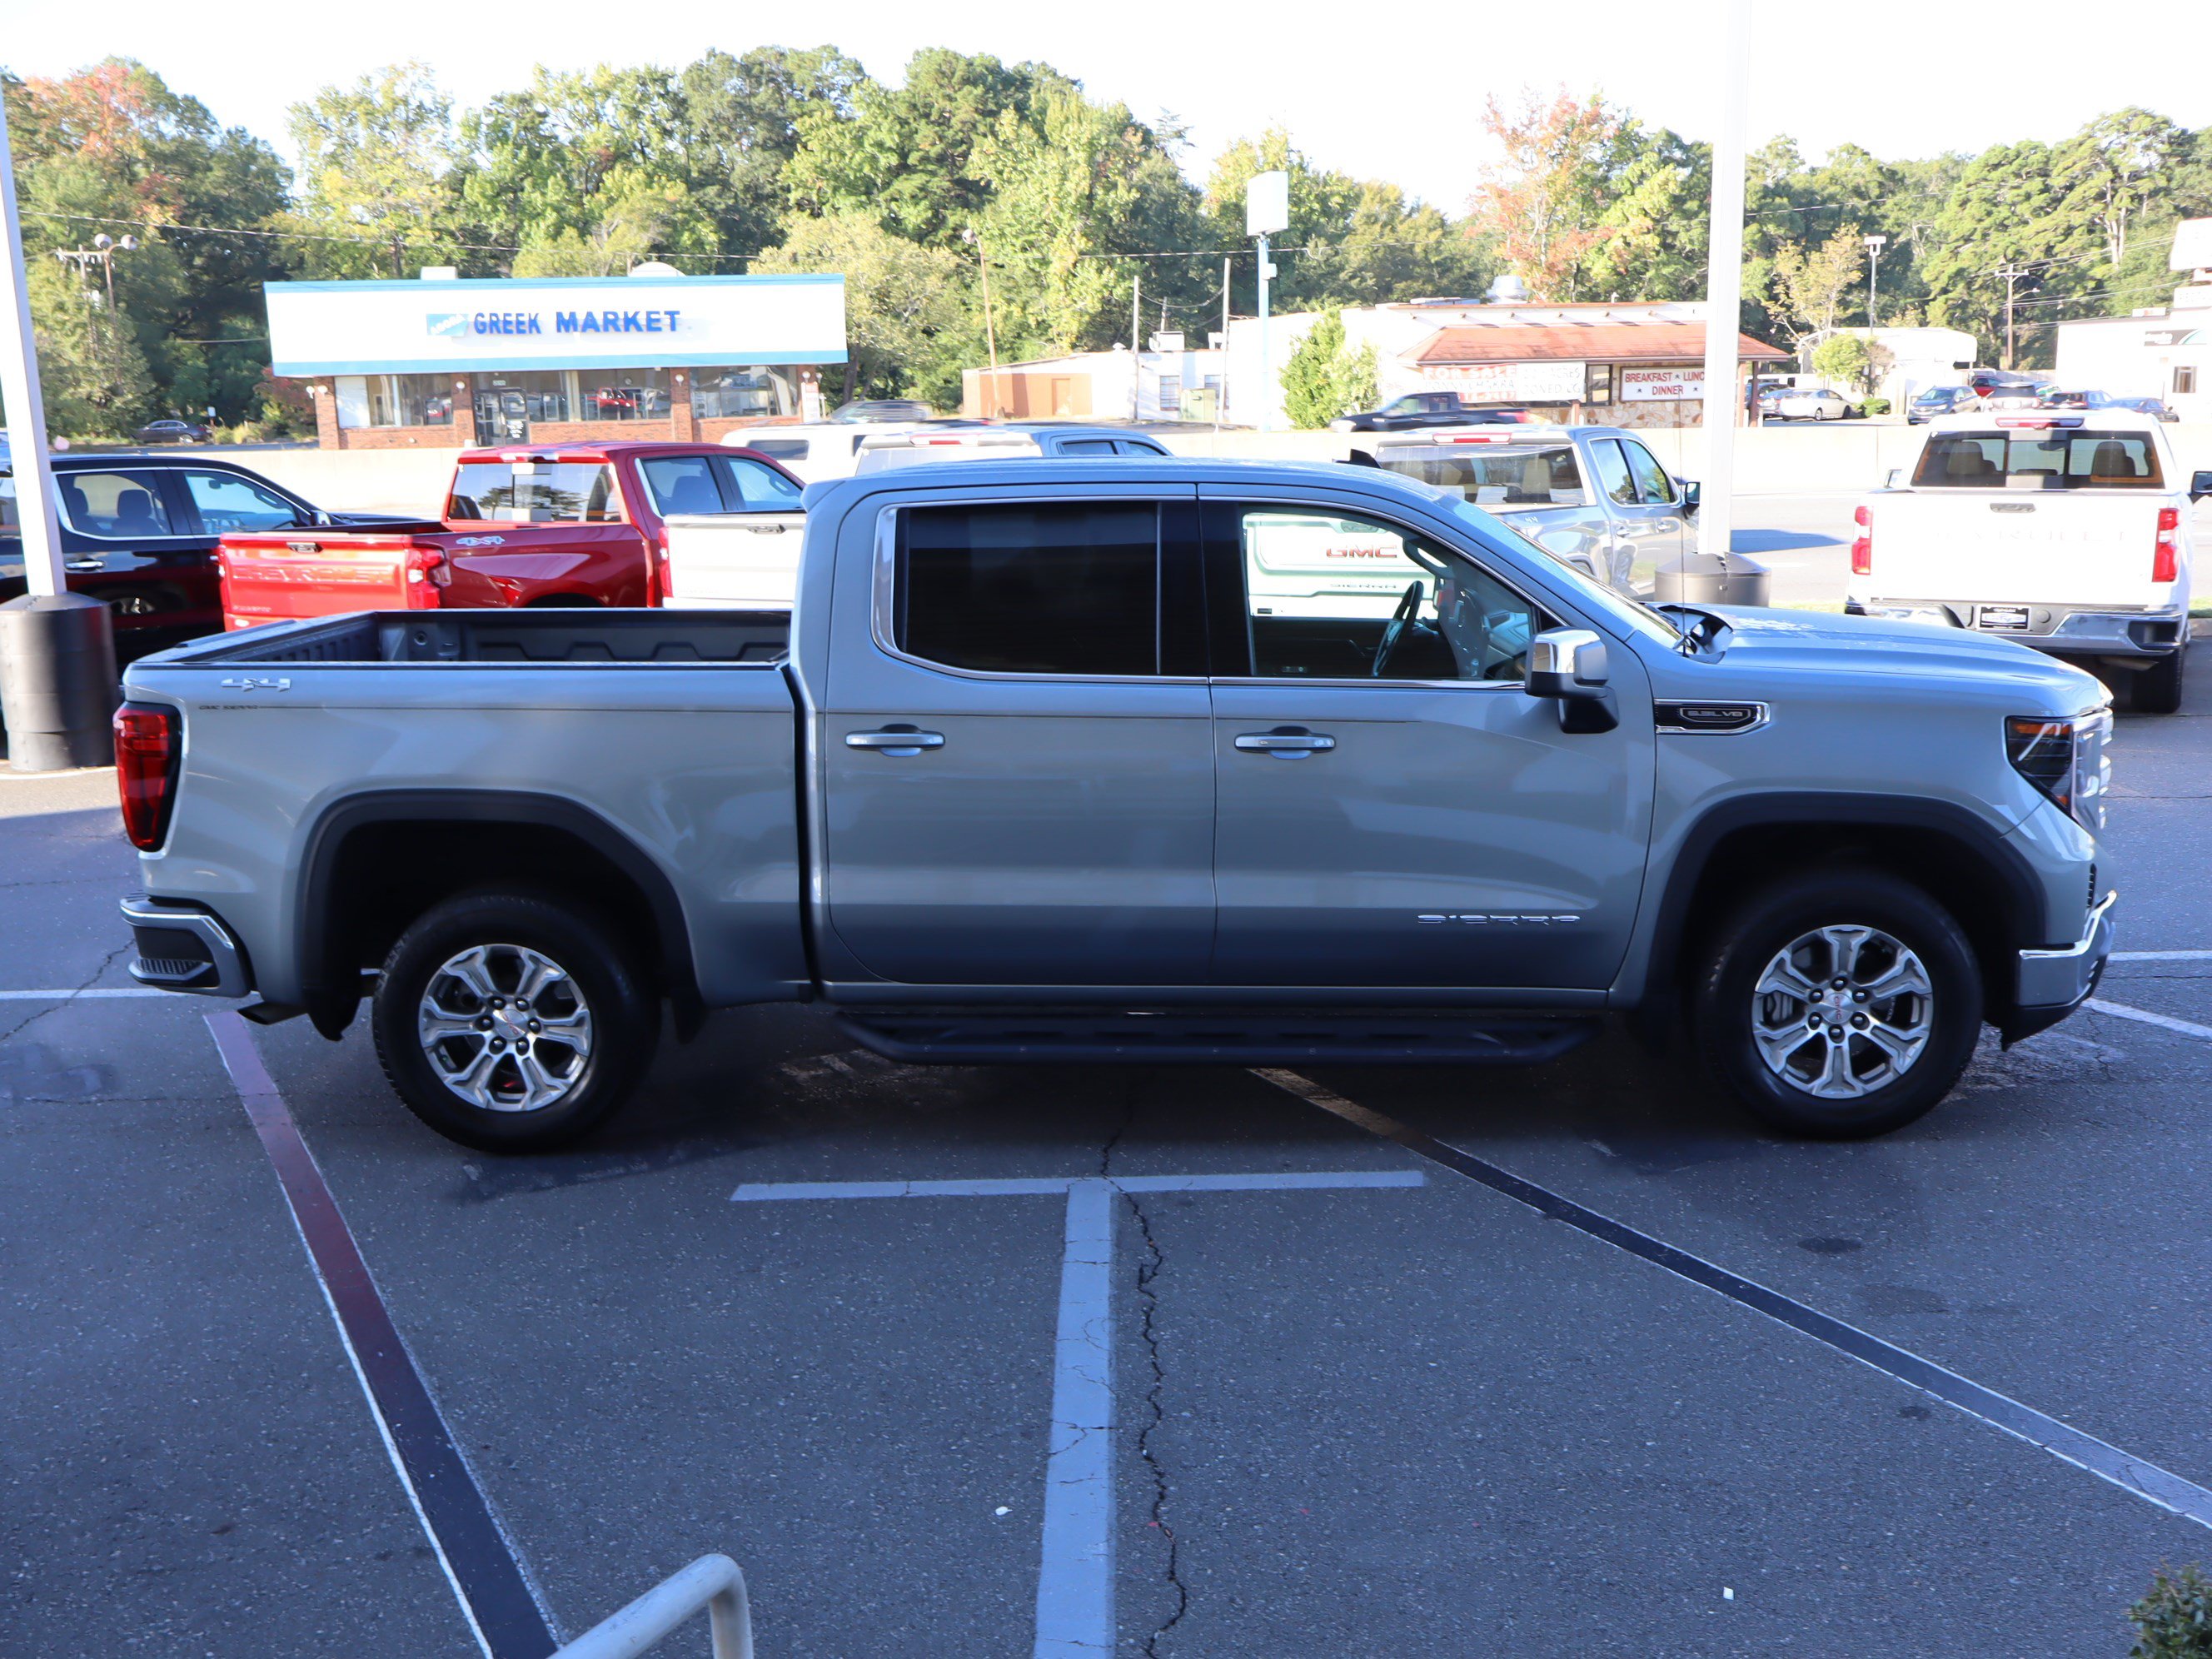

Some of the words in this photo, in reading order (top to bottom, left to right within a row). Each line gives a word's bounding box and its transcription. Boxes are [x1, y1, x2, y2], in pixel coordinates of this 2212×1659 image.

[474, 312, 542, 335] GREEK
[555, 310, 680, 333] MARKET
[1423, 367, 1462, 380] FOR
[1468, 365, 1517, 379] SALE
[1625, 372, 1673, 382] BREAKFAST
[1683, 371, 1705, 381] LUNC
[1652, 384, 1684, 396] DINNER
[1326, 545, 1397, 559] GMC
[232, 564, 392, 584] CHEVROLET
[1417, 914, 1581, 926] SIERRA
